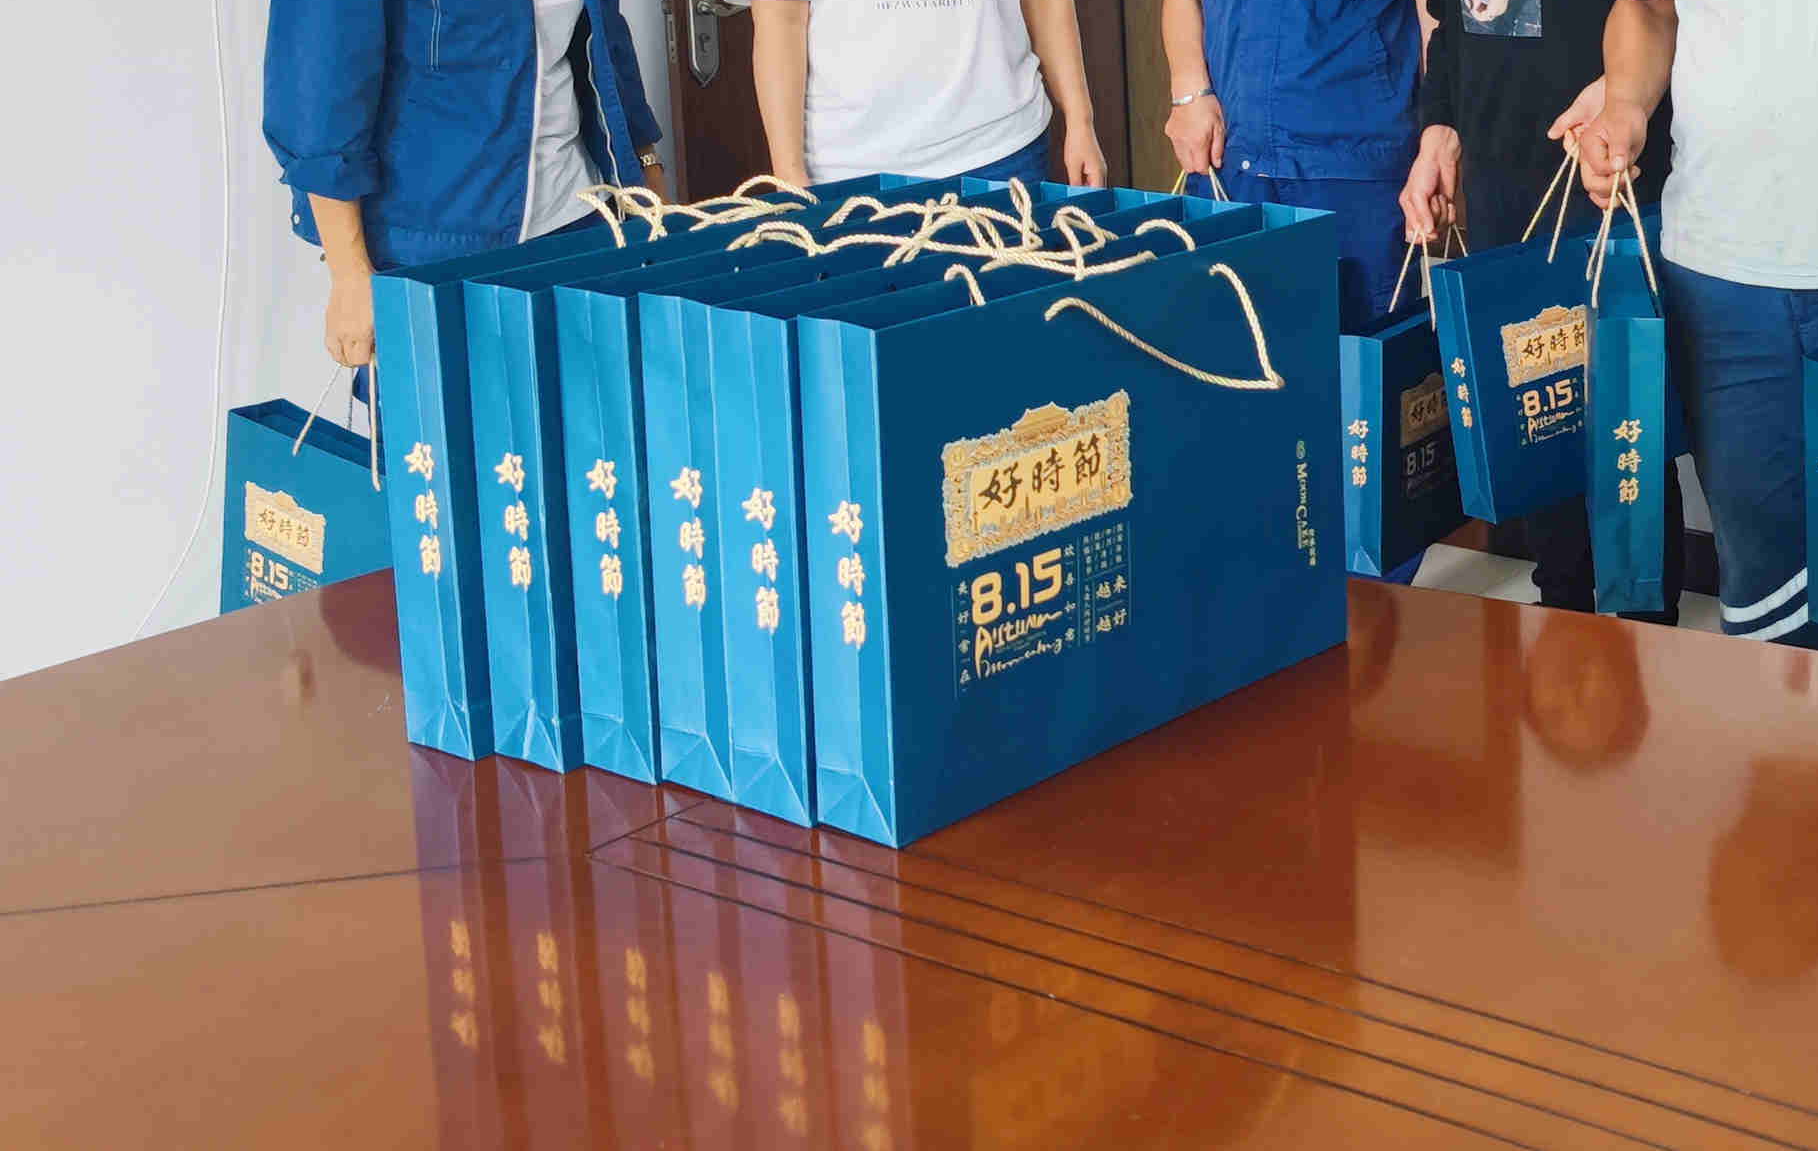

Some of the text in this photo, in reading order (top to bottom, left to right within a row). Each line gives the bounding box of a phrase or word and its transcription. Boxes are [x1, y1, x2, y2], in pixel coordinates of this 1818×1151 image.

[1348, 418, 1368, 488] 好時節
[1522, 379, 1573, 417] 8.15
[404, 442, 441, 577] 好時節
[978, 432, 1101, 512] 好時節
[1614, 419, 1642, 505] 好時節
[251, 551, 289, 590] 8.15
[494, 451, 532, 592] 好時節
[586, 458, 622, 600] 好時節
[670, 466, 706, 611] 好時節
[742, 487, 780, 635] 好時節
[828, 500, 866, 650] 好時節
[971, 548, 1062, 625] 8.15
